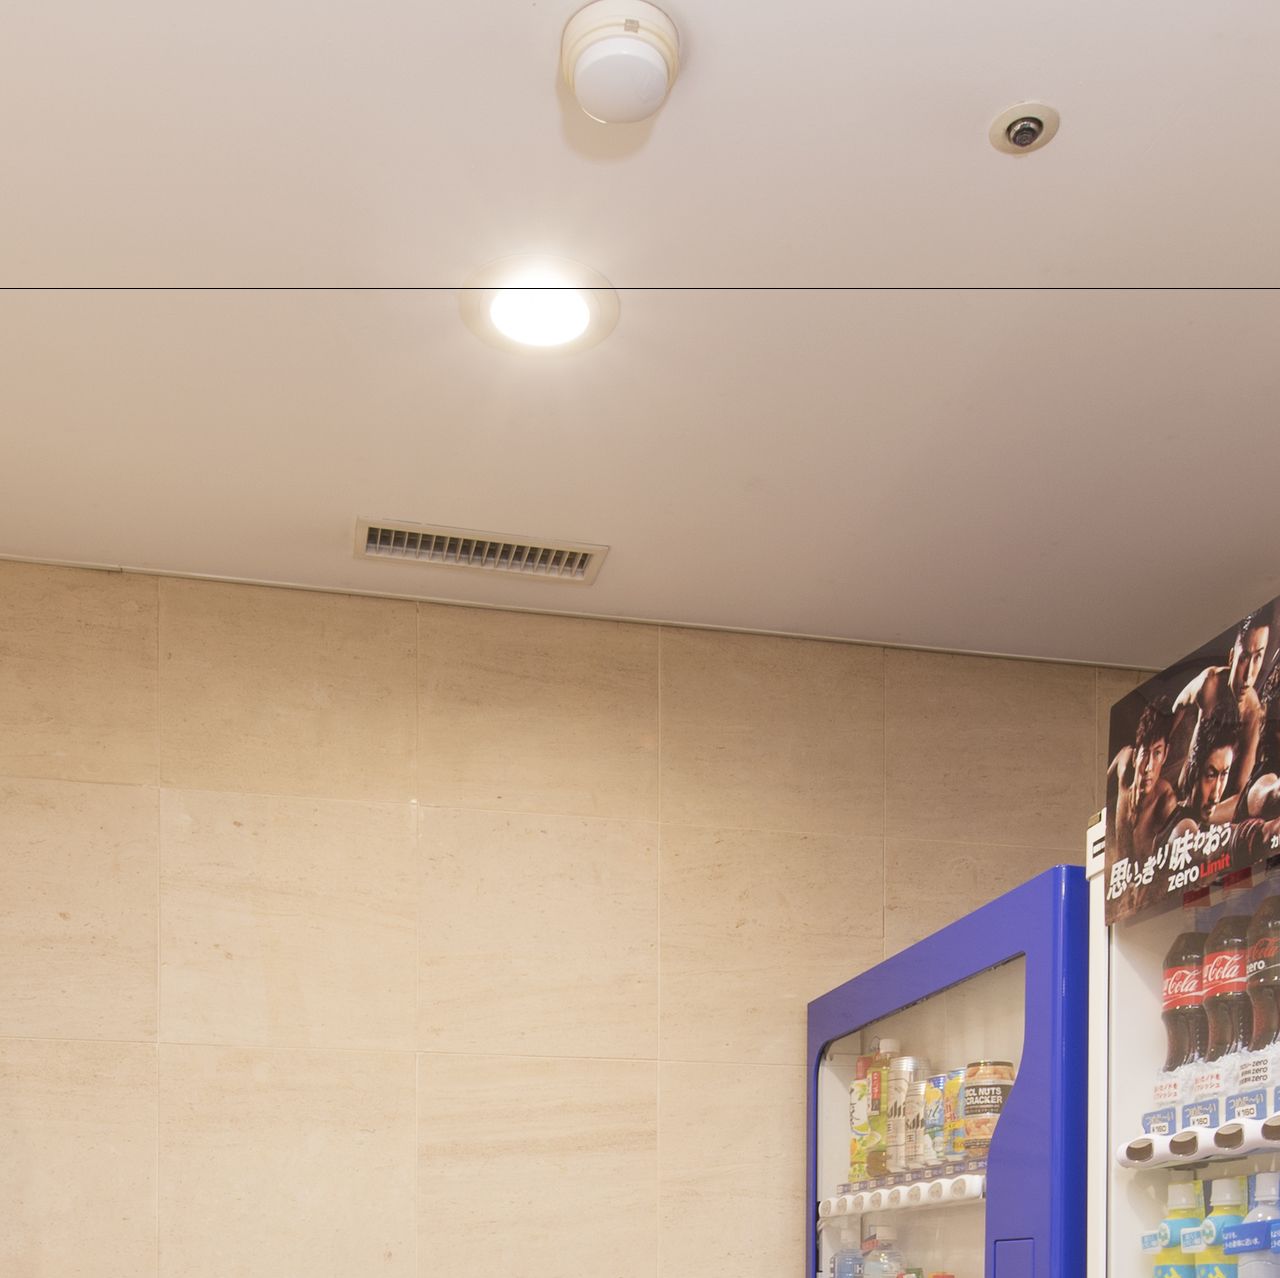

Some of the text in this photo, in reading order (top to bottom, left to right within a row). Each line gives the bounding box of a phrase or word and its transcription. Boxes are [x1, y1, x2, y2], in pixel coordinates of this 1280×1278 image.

[1107, 822, 1230, 900] 思いっきり 味わおう
[1168, 857, 1230, 892] zero Limit
[978, 1087, 1001, 1096] NUTS
